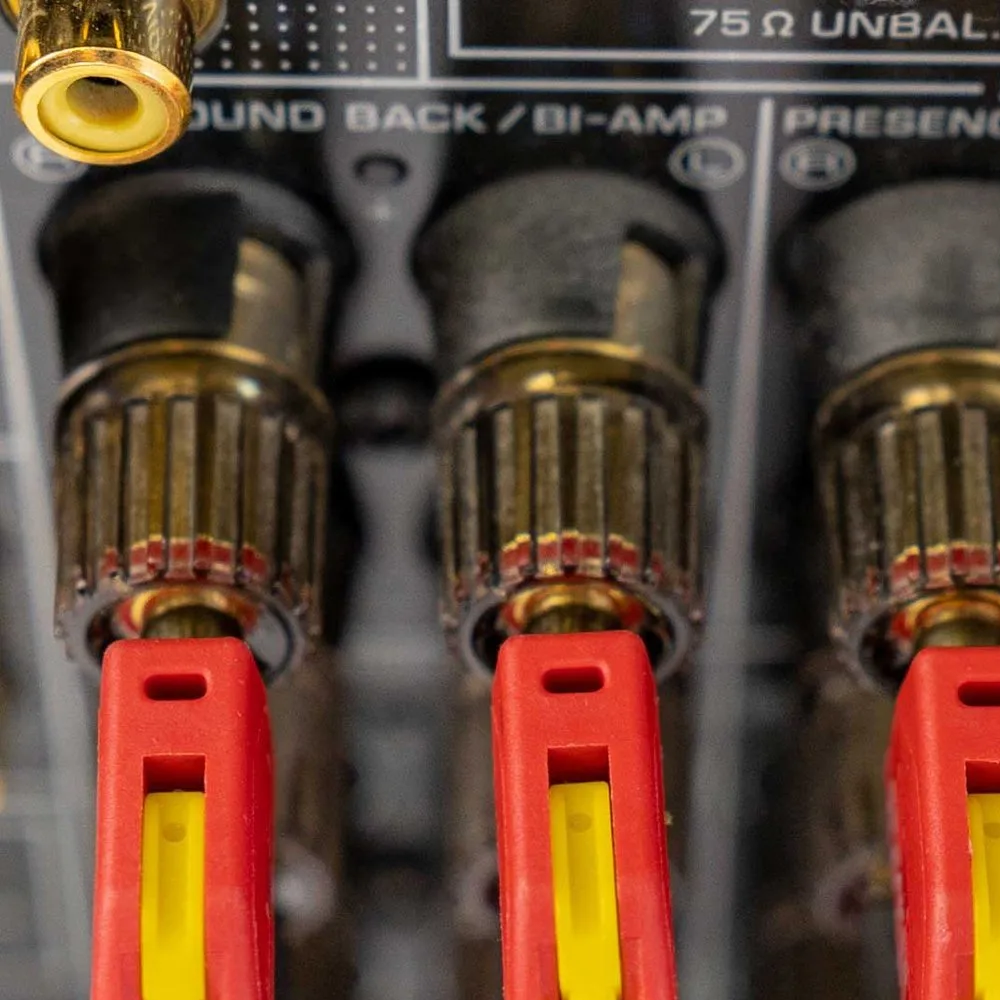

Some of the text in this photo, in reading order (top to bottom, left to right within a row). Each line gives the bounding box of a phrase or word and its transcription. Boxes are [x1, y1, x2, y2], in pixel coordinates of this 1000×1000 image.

[689, 9, 1000, 40] 75 Ω UNBAL.
